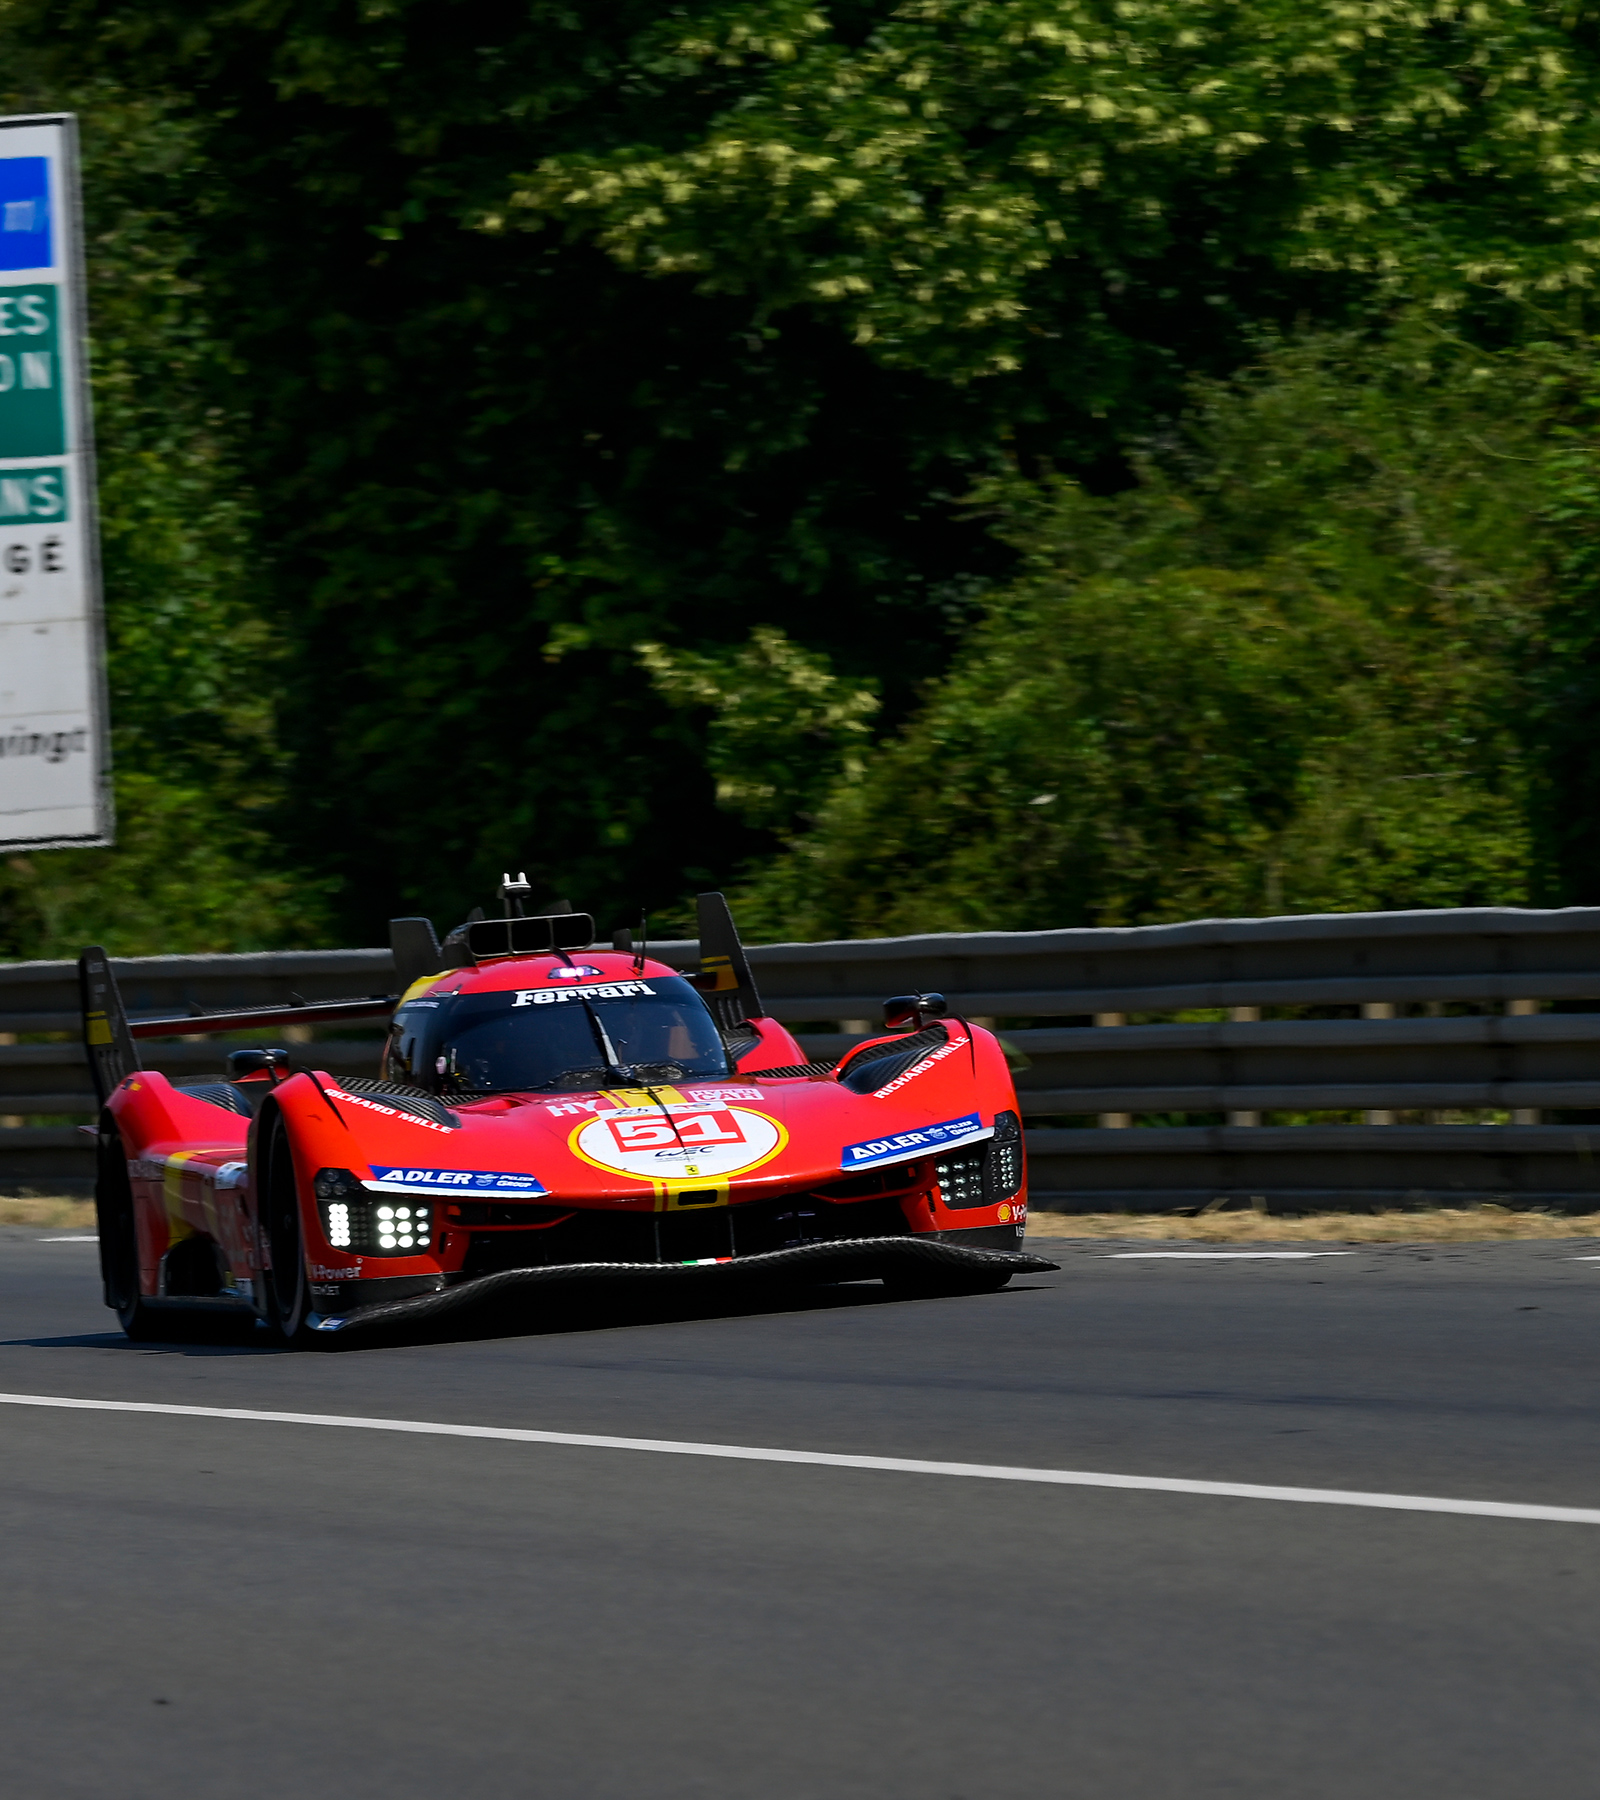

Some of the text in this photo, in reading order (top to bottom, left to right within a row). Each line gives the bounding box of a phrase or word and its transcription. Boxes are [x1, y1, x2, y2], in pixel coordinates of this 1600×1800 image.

[511, 981, 656, 1007] Ferrari
[873, 1036, 970, 1099] RICHARD MILLE
[324, 1087, 454, 1134] RICHARD MILLE
[546, 1099, 598, 1117] HY
[614, 1114, 738, 1148] 51
[654, 1145, 716, 1158] WEC
[850, 1131, 931, 1160] ADLER
[379, 1170, 473, 1185] ADLER
